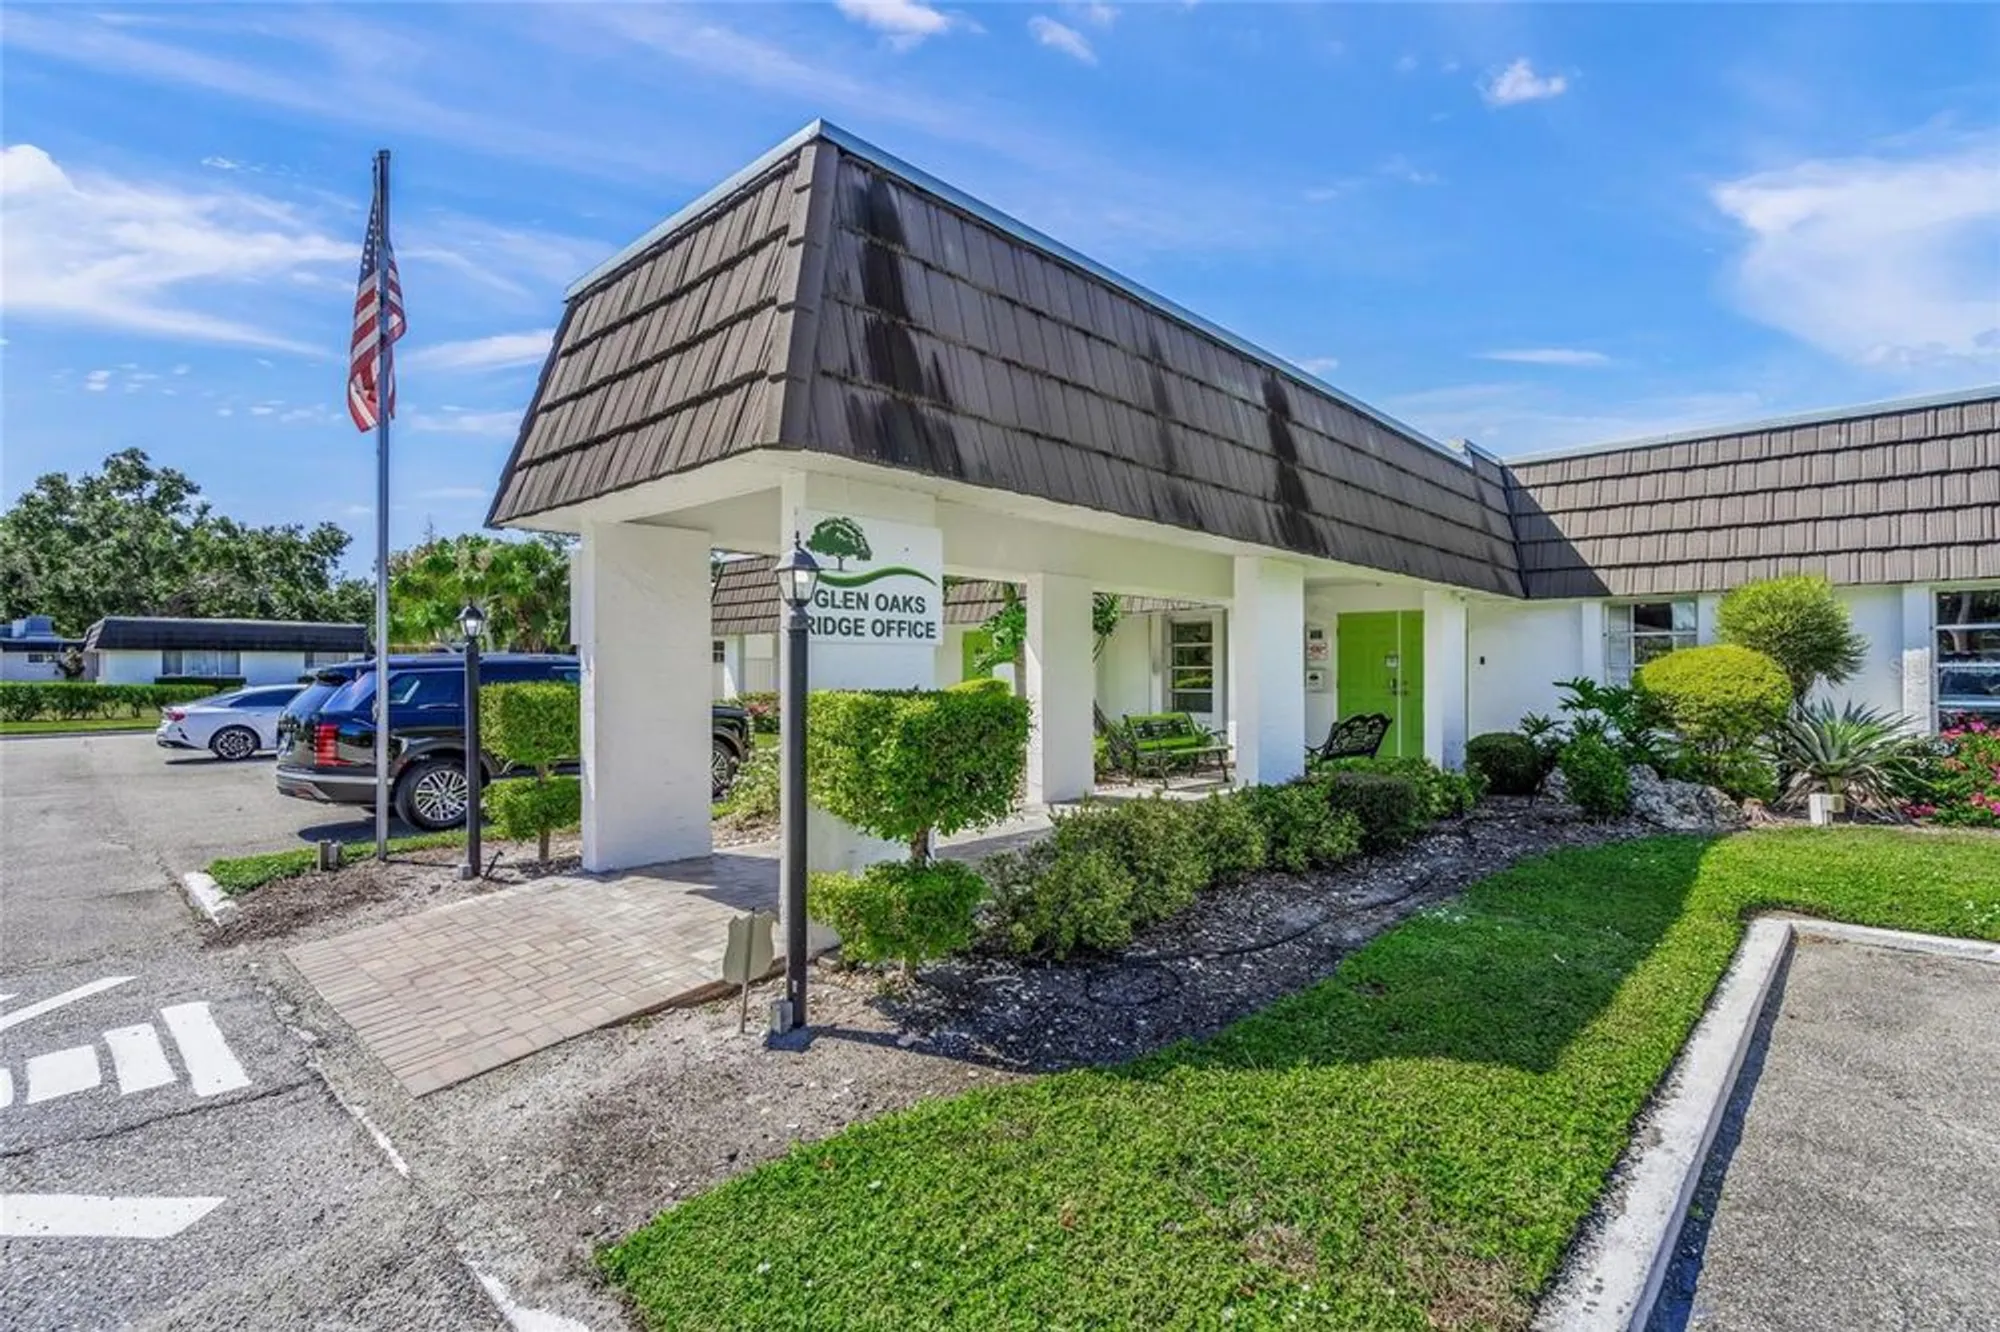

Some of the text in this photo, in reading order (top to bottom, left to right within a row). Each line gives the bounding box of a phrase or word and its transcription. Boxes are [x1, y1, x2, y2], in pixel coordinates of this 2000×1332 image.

[814, 589, 926, 614] GLEN OAKS
[871, 618, 936, 639] OFFICE
